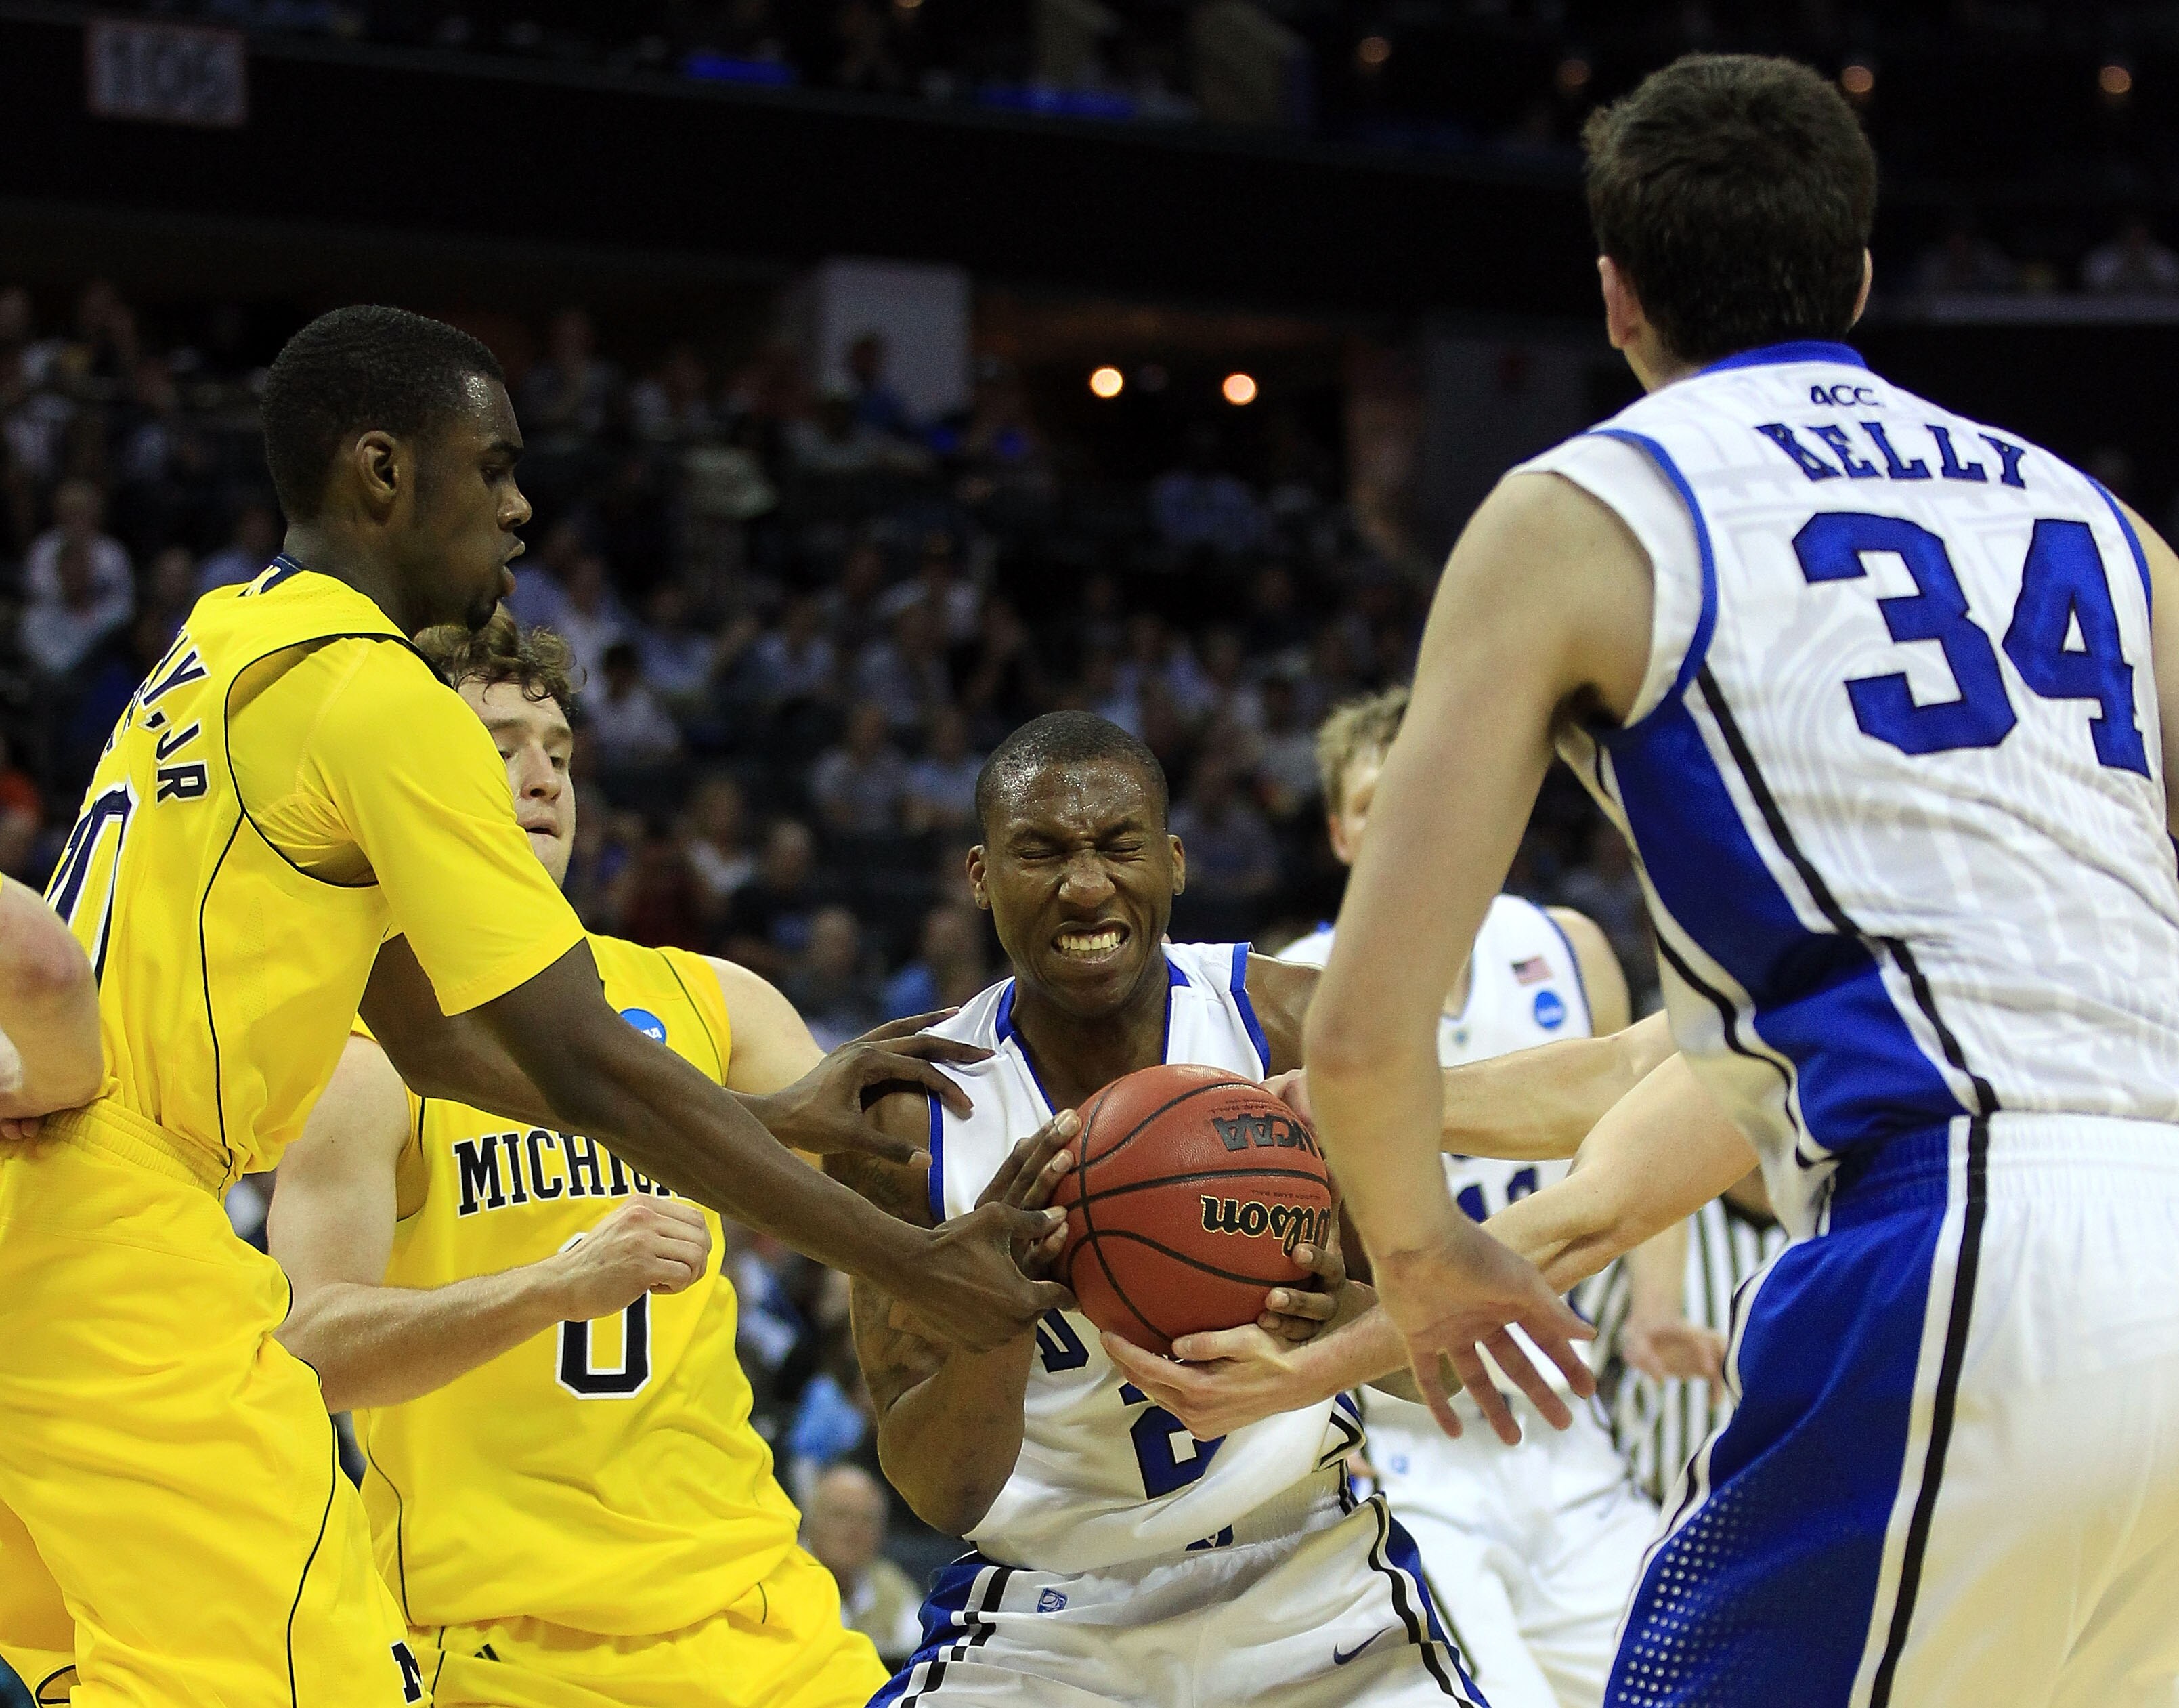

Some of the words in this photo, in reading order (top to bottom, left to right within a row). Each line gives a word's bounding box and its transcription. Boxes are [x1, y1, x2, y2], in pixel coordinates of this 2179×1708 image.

[1810, 385, 1880, 406] ACC
[1754, 421, 2027, 489] KELLY
[1792, 512, 2152, 780] 34
[1212, 1113, 1324, 1161] NCAA
[452, 1129, 677, 1218] MICHI
[1200, 1194, 1332, 1258] Wilson
